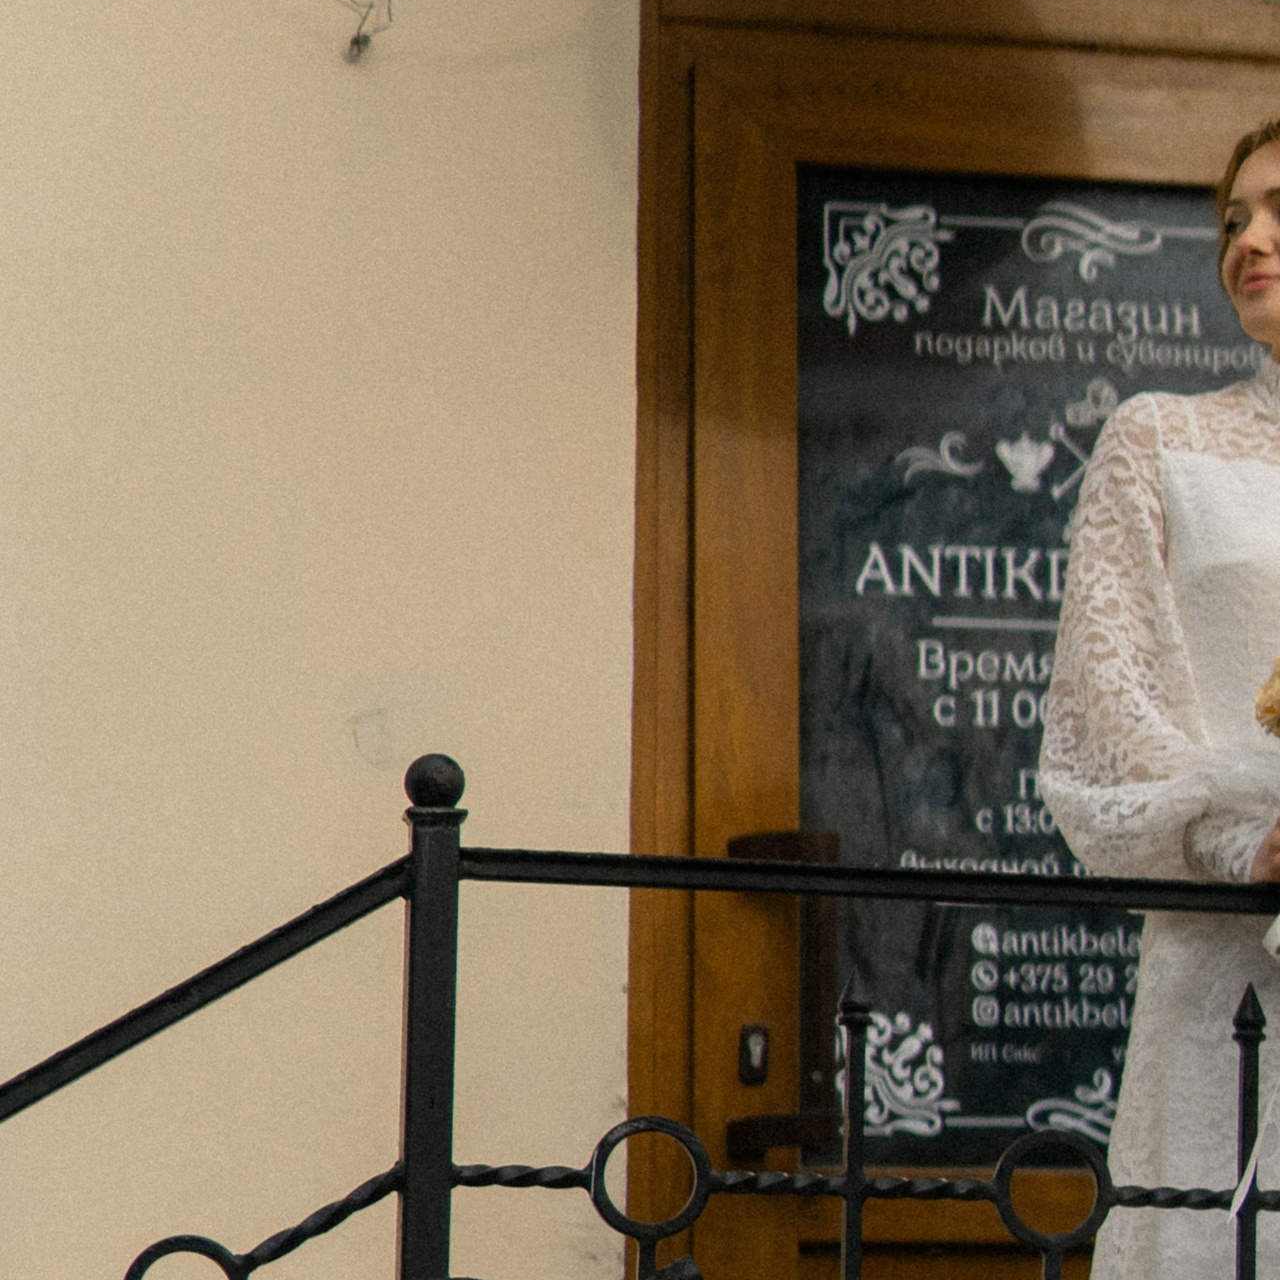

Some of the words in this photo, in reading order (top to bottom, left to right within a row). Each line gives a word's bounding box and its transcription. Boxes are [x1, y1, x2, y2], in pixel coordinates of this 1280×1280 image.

[980, 283, 1201, 344] Магазин
[914, 330, 1067, 367] подарков
[1076, 339, 1097, 365] и
[932, 694, 958, 729] с
[971, 688, 1001, 729] 11
[975, 806, 994, 835] с
[1004, 961, 1070, 995] +375
[1004, 996, 1135, 1029] antikbel
